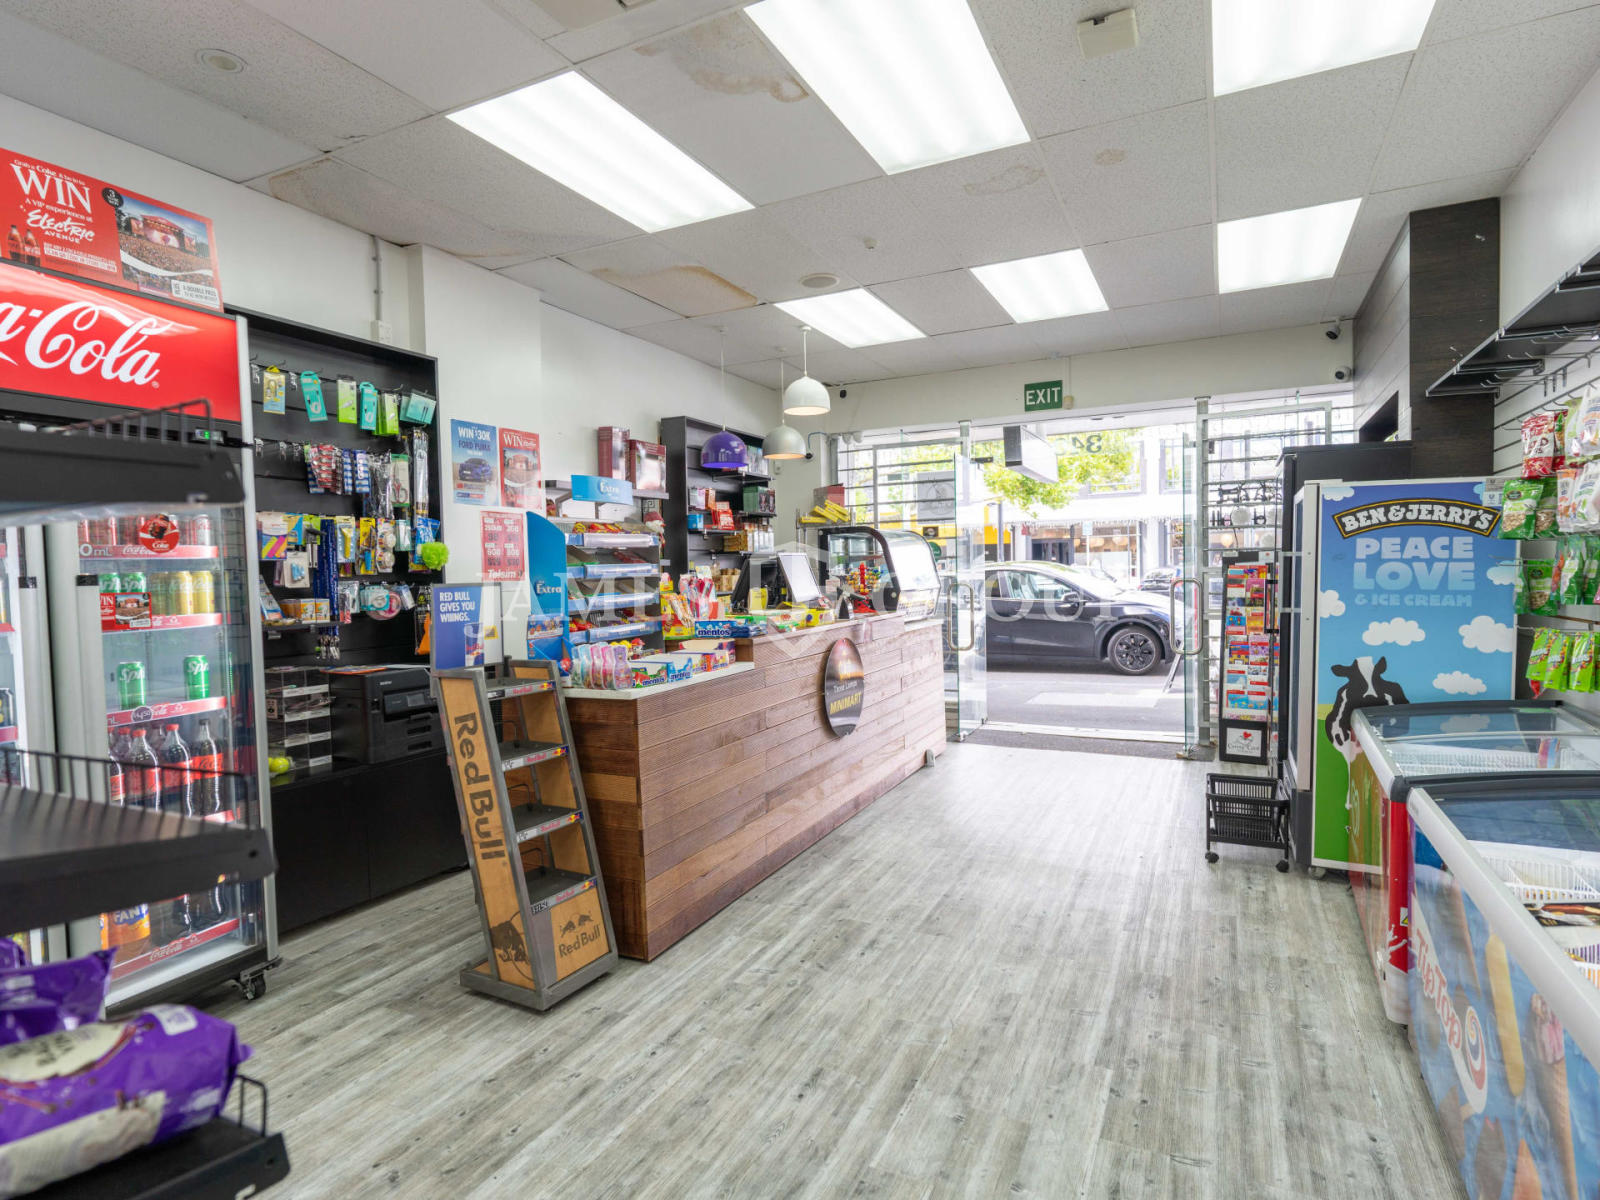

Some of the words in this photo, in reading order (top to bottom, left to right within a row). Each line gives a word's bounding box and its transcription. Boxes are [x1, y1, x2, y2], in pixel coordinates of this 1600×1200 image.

[10, 163, 92, 214] WIN
[44, 230, 80, 244] AVENUE
[1026, 387, 1061, 406] EXIT
[458, 426, 474, 439] WIN
[503, 433, 522, 447] WIN
[458, 440, 474, 449] FORD
[1342, 507, 1386, 532] BEN
[1388, 505, 1406, 522] &
[1406, 504, 1493, 530] JERRY'S
[1355, 536, 1474, 560] PEACE
[1353, 561, 1476, 591] LOVE
[439, 591, 453, 602] RED
[454, 591, 470, 601] BULL
[1355, 594, 1369, 606] &
[1371, 594, 1400, 606] ICE
[1404, 594, 1473, 607] CREAM
[440, 602, 460, 612] GIVES
[461, 601, 475, 611] YOU
[697, 627, 731, 637] mentos
[829, 691, 862, 715] MINIMART
[454, 712, 490, 786] Red
[469, 789, 506, 861] Bull
[558, 935, 581, 958] Red
[580, 924, 601, 946] Bull
